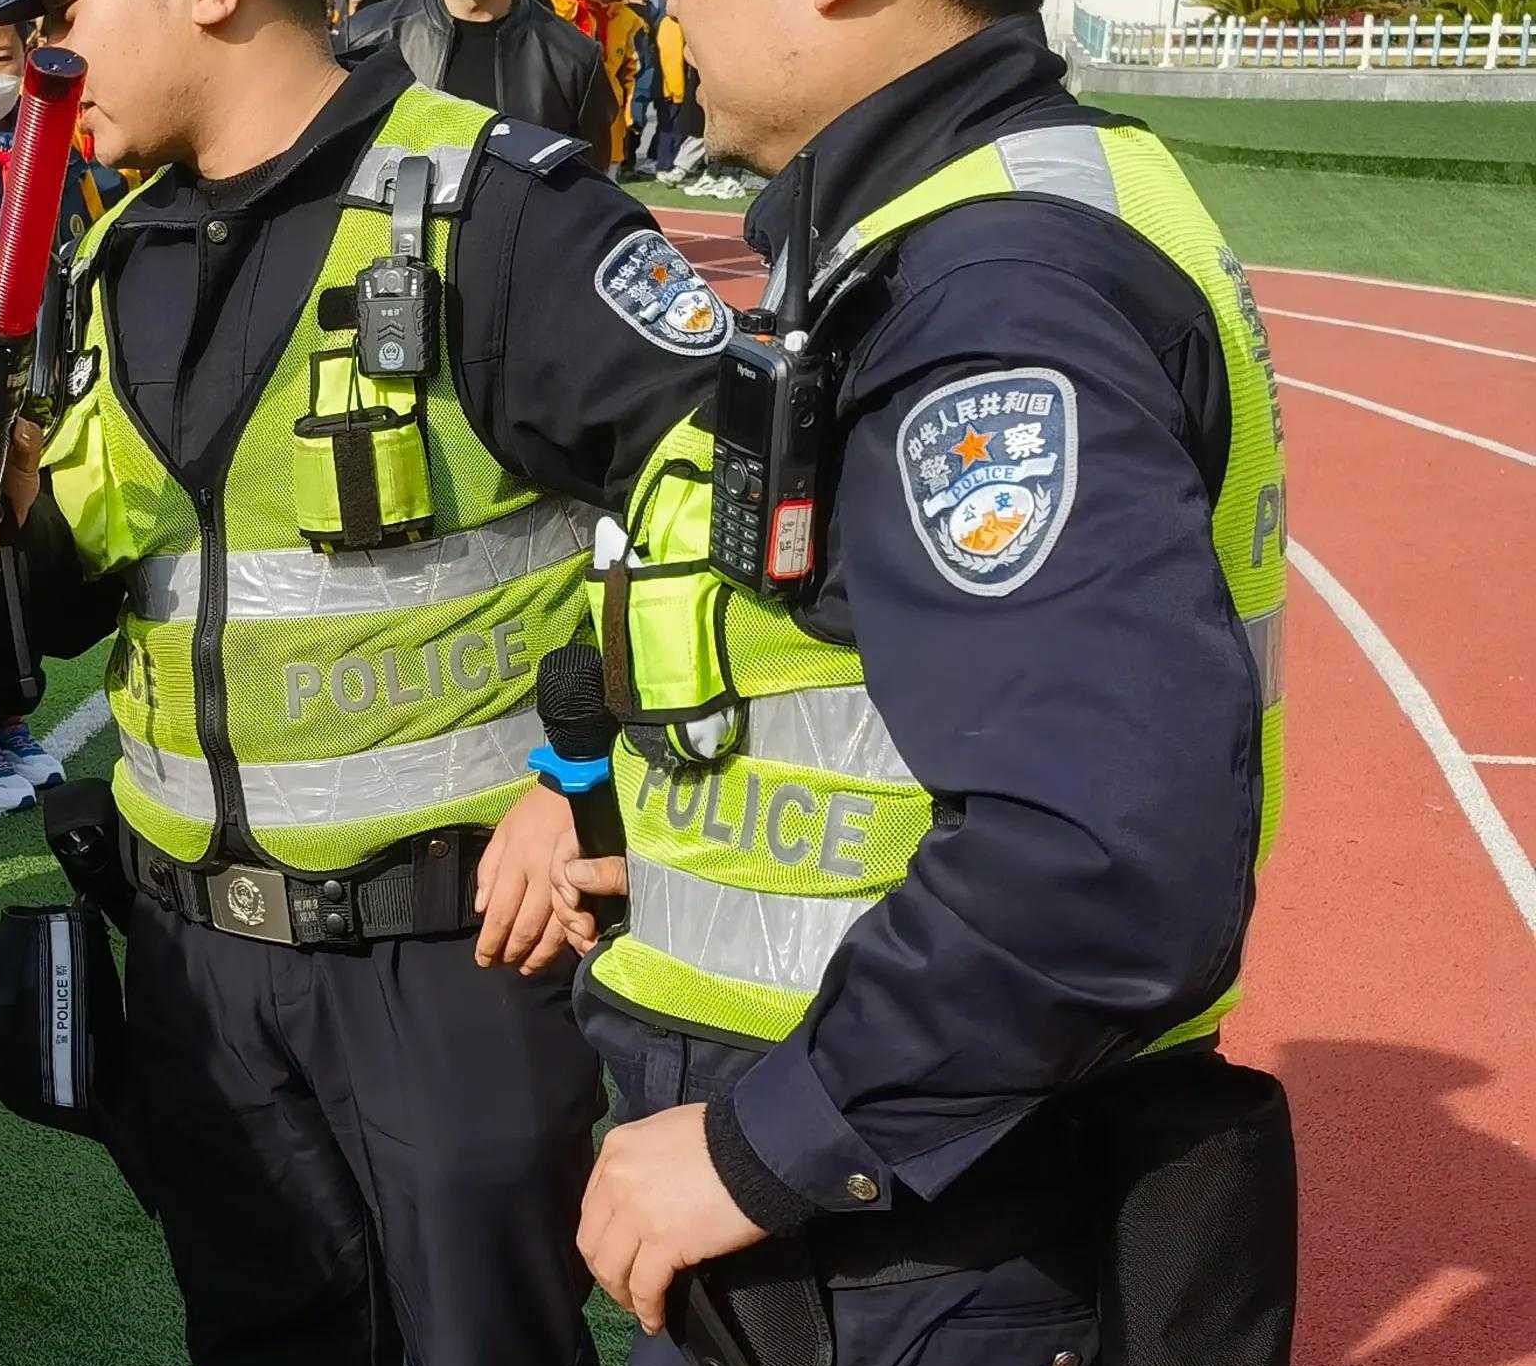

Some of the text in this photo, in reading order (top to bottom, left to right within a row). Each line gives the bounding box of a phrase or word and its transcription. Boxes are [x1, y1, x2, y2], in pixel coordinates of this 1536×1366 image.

[907, 391, 1054, 462] 中华人民共和国
[952, 467, 1015, 500] POLICE
[284, 618, 532, 721] POLICE
[56, 979, 69, 1030] POLICE
